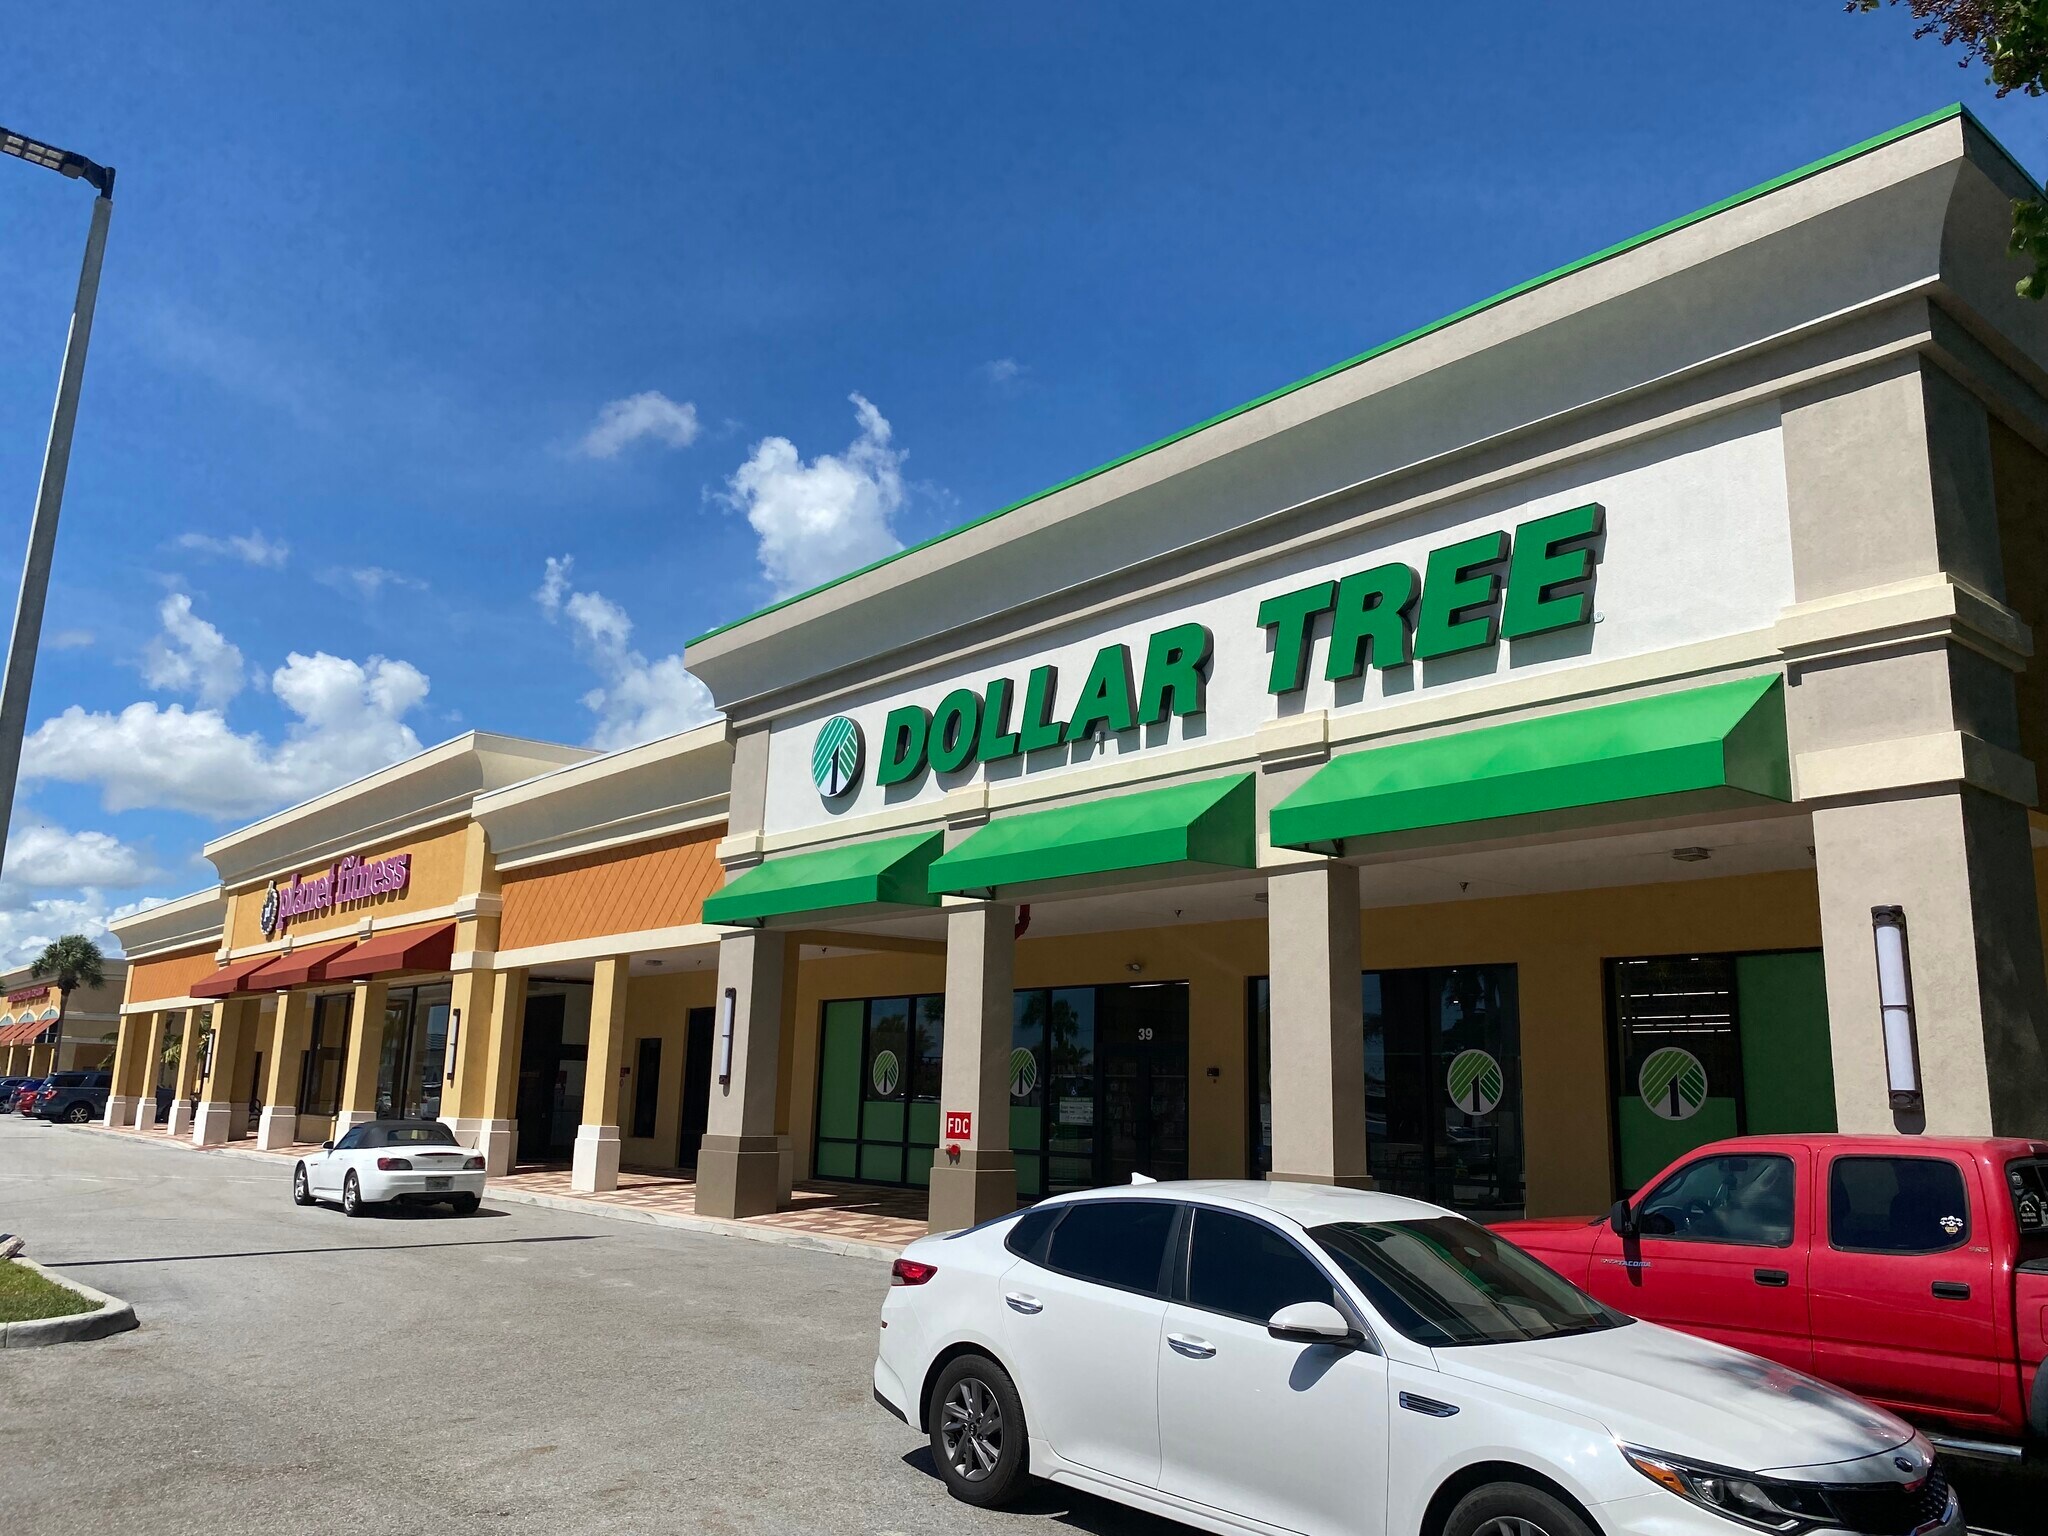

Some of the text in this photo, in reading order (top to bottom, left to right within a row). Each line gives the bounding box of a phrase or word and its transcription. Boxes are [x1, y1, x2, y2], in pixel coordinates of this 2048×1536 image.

[876, 622, 1211, 787] DOLLAR
[1256, 502, 1604, 695] TREE
[276, 854, 410, 931] planet fitness
[1138, 1028, 1153, 1040] 39
[947, 1117, 969, 1134] FDC
